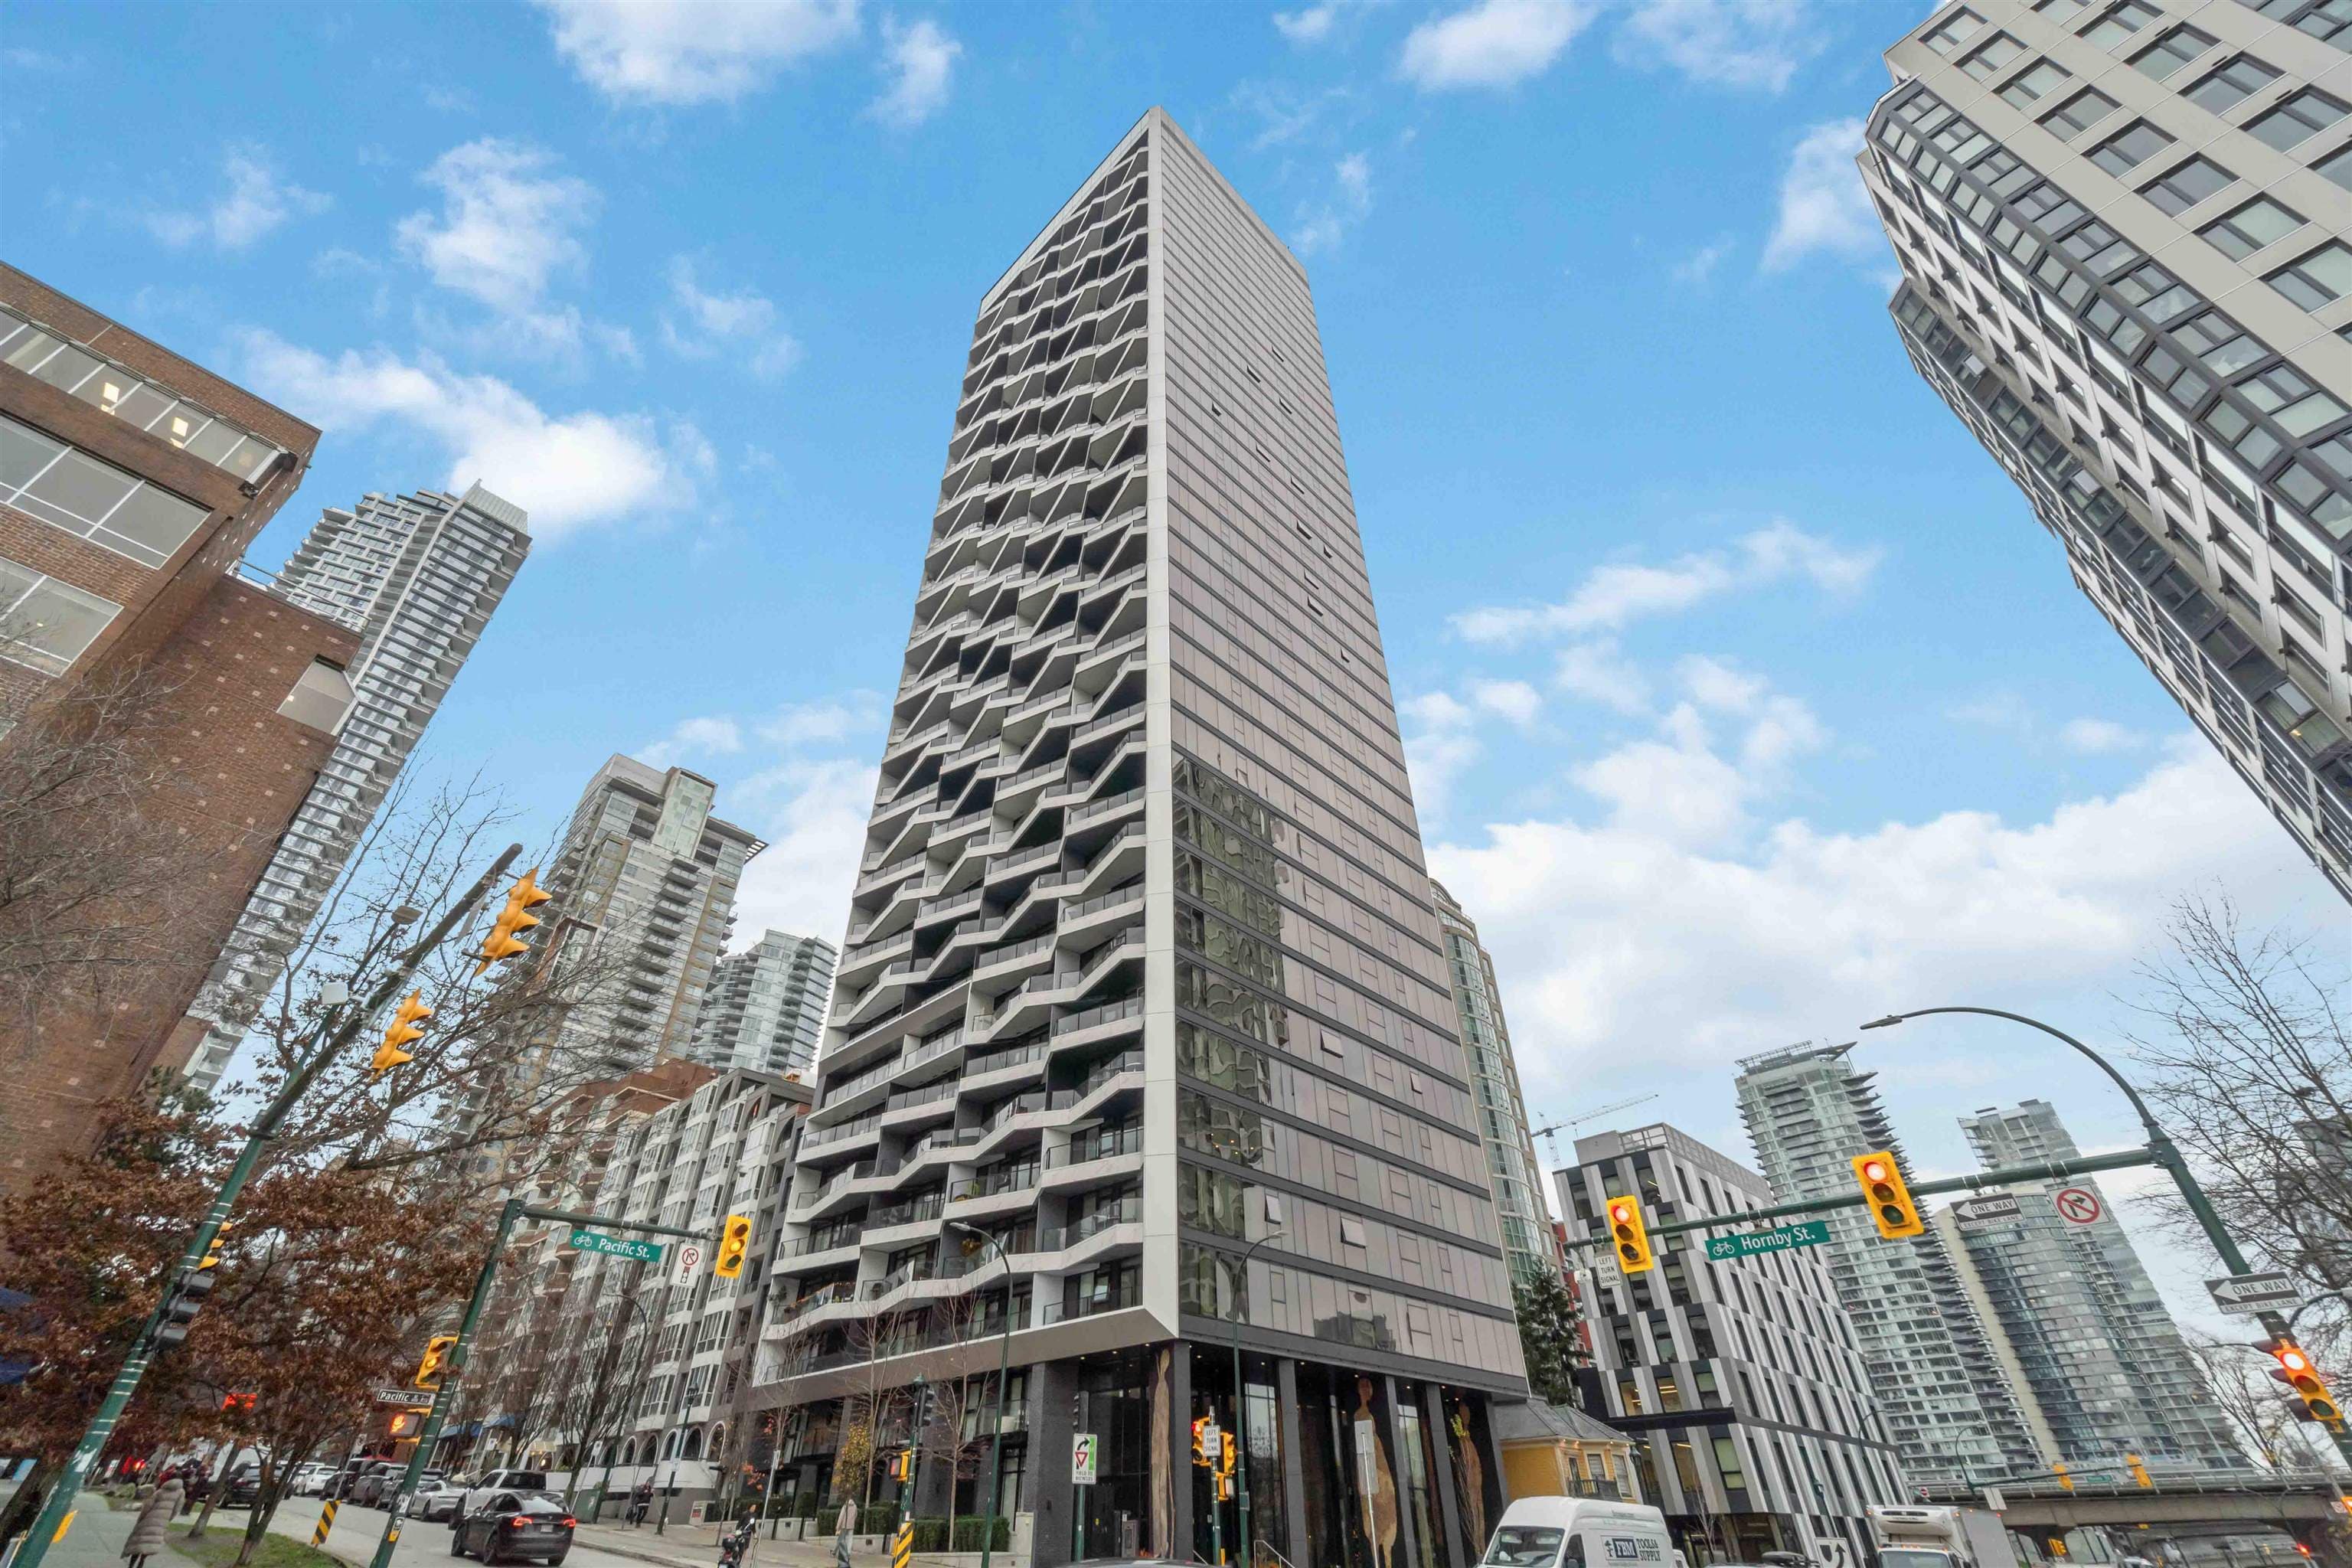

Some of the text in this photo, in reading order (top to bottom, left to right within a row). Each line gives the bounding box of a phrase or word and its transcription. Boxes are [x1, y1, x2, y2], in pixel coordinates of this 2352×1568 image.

[1971, 1200, 2014, 1214] ONE WAY
[1740, 1227, 1816, 1250] Hornby St.
[598, 1238, 650, 1258] Pacific St.
[1600, 1276, 1619, 1284] SIGNAL
[2232, 1279, 2288, 1295] ONE WAY
[2225, 1303, 2254, 1312] EXCEPT
[380, 1392, 410, 1402] Pacific
[1615, 1540, 1636, 1557] FBM
[1639, 1550, 1661, 1561] SUPPLY
